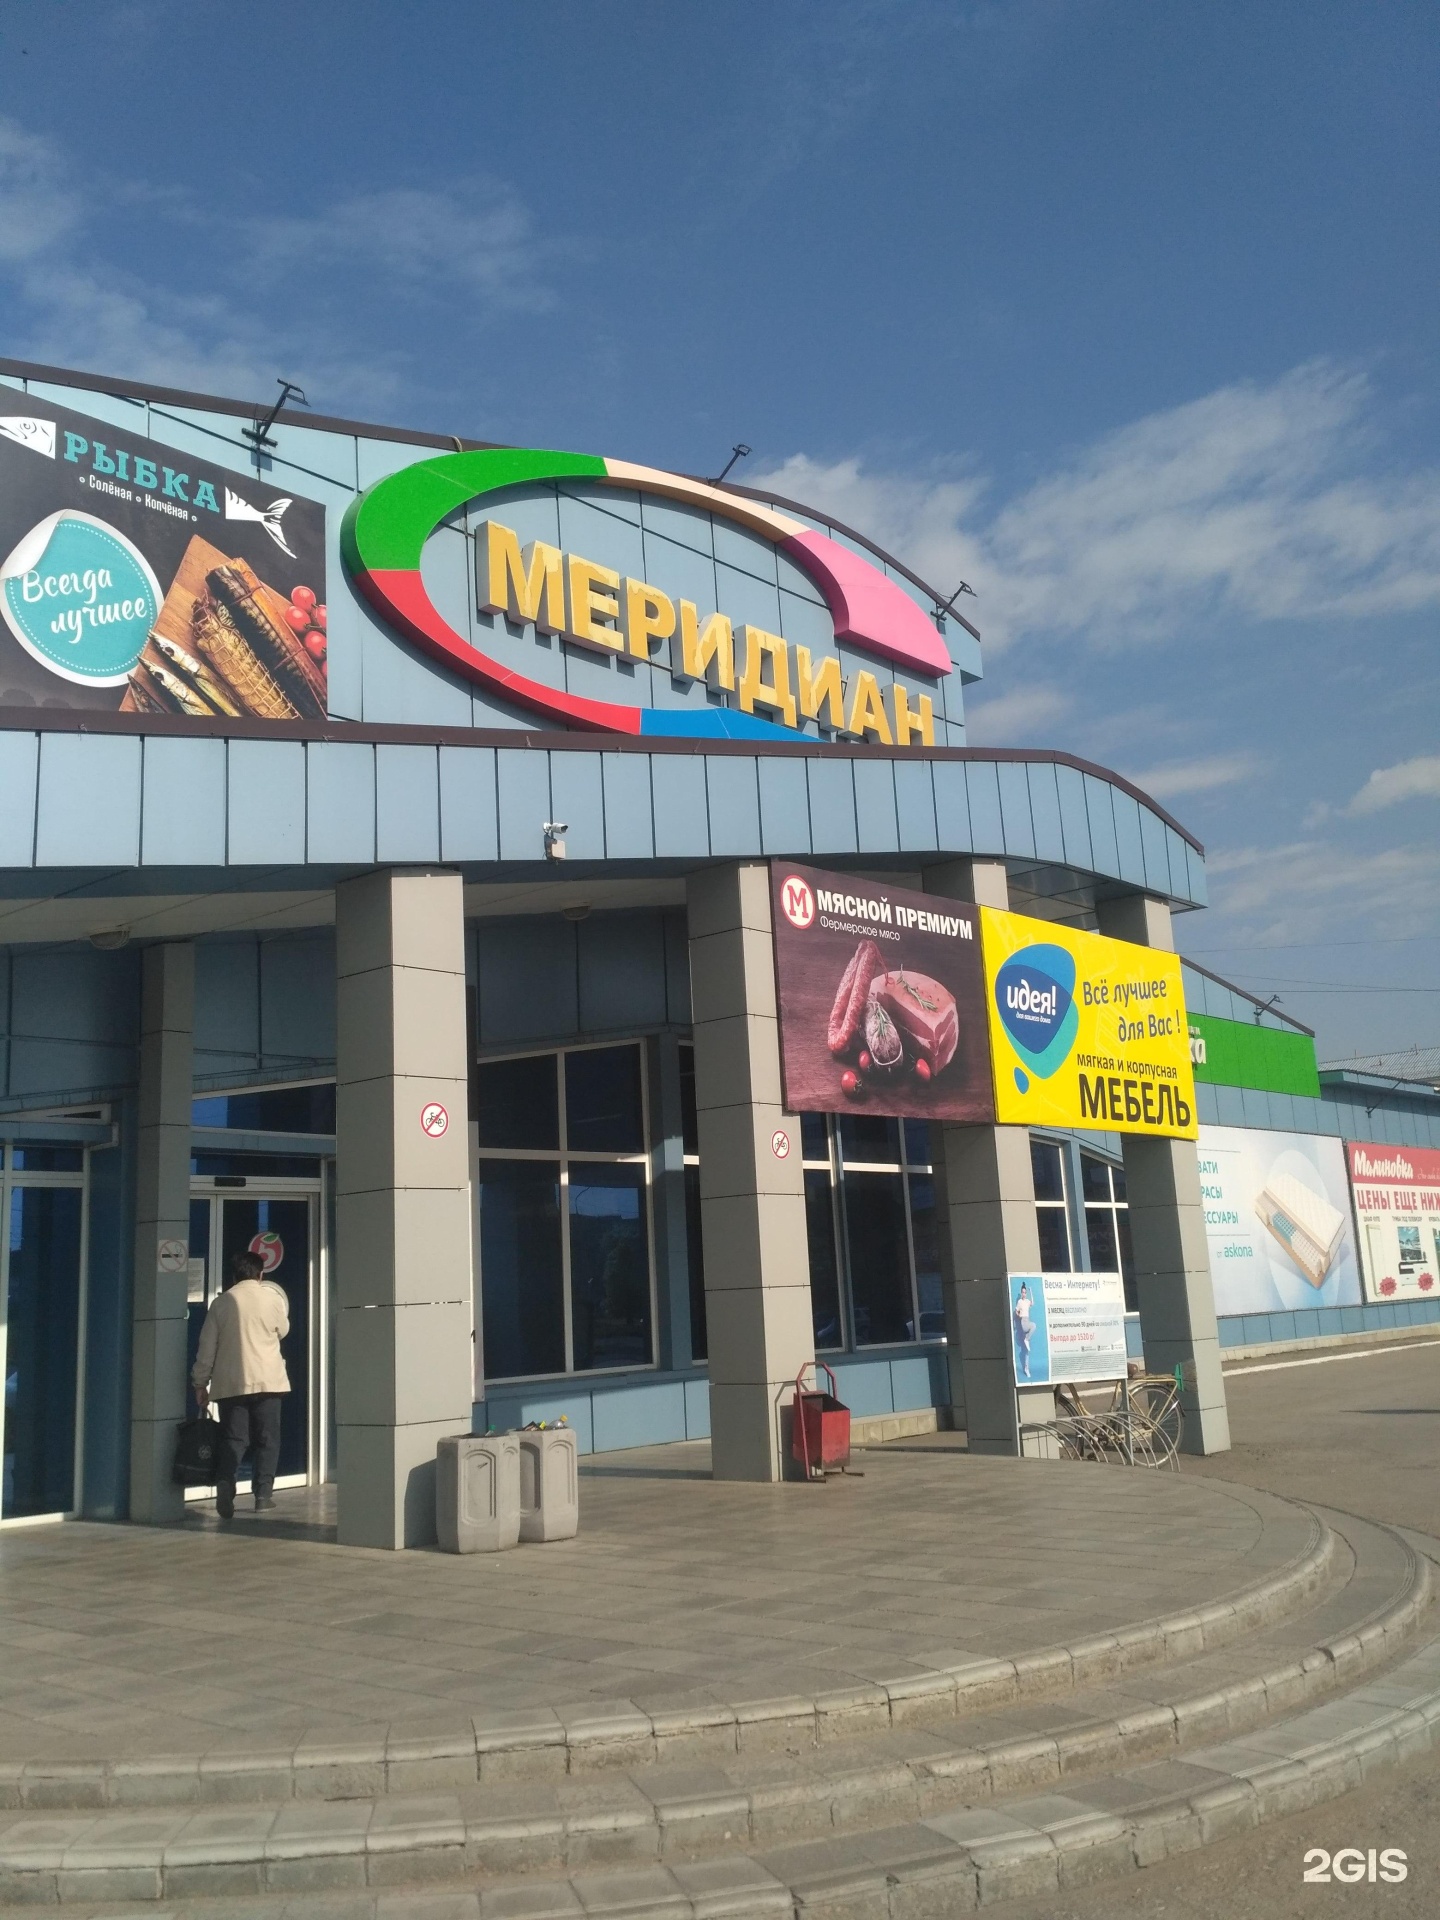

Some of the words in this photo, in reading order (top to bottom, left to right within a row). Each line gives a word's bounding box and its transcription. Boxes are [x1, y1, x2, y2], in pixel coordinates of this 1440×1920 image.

[63, 430, 220, 514] РЫБКА
[89, 474, 132, 501] Солёная
[145, 493, 188, 520] Копчёная
[18, 568, 113, 604] Всегда
[51, 597, 147, 644] лучшее
[475, 520, 935, 747] МЕРИДИАН
[816, 889, 892, 924] МЯСНОЙ
[895, 905, 973, 940] ПРЕМИУМ
[819, 915, 878, 936] Фермерское
[878, 929, 901, 941] мясо
[1006, 978, 1056, 1016] идея!
[1083, 979, 1108, 1006] Всё
[1113, 979, 1167, 1008] лучшее
[1118, 1016, 1144, 1042] для
[1148, 1013, 1173, 1038] Вас
[1077, 1053, 1115, 1071] мягкая
[1117, 1060, 1124, 1072] и
[1126, 1060, 1177, 1080] корпусная
[1078, 1073, 1191, 1127] МЕБЕЛЬ
[1354, 1149, 1414, 1180] Малиновка
[1356, 1190, 1391, 1213] ЦЕНЫ
[1393, 1191, 1418, 1213] ЕЩЕ
[1224, 1243, 1253, 1258] askona
[1044, 1279, 1062, 1289] Весна
[1050, 1334, 1069, 1342] Выгода
